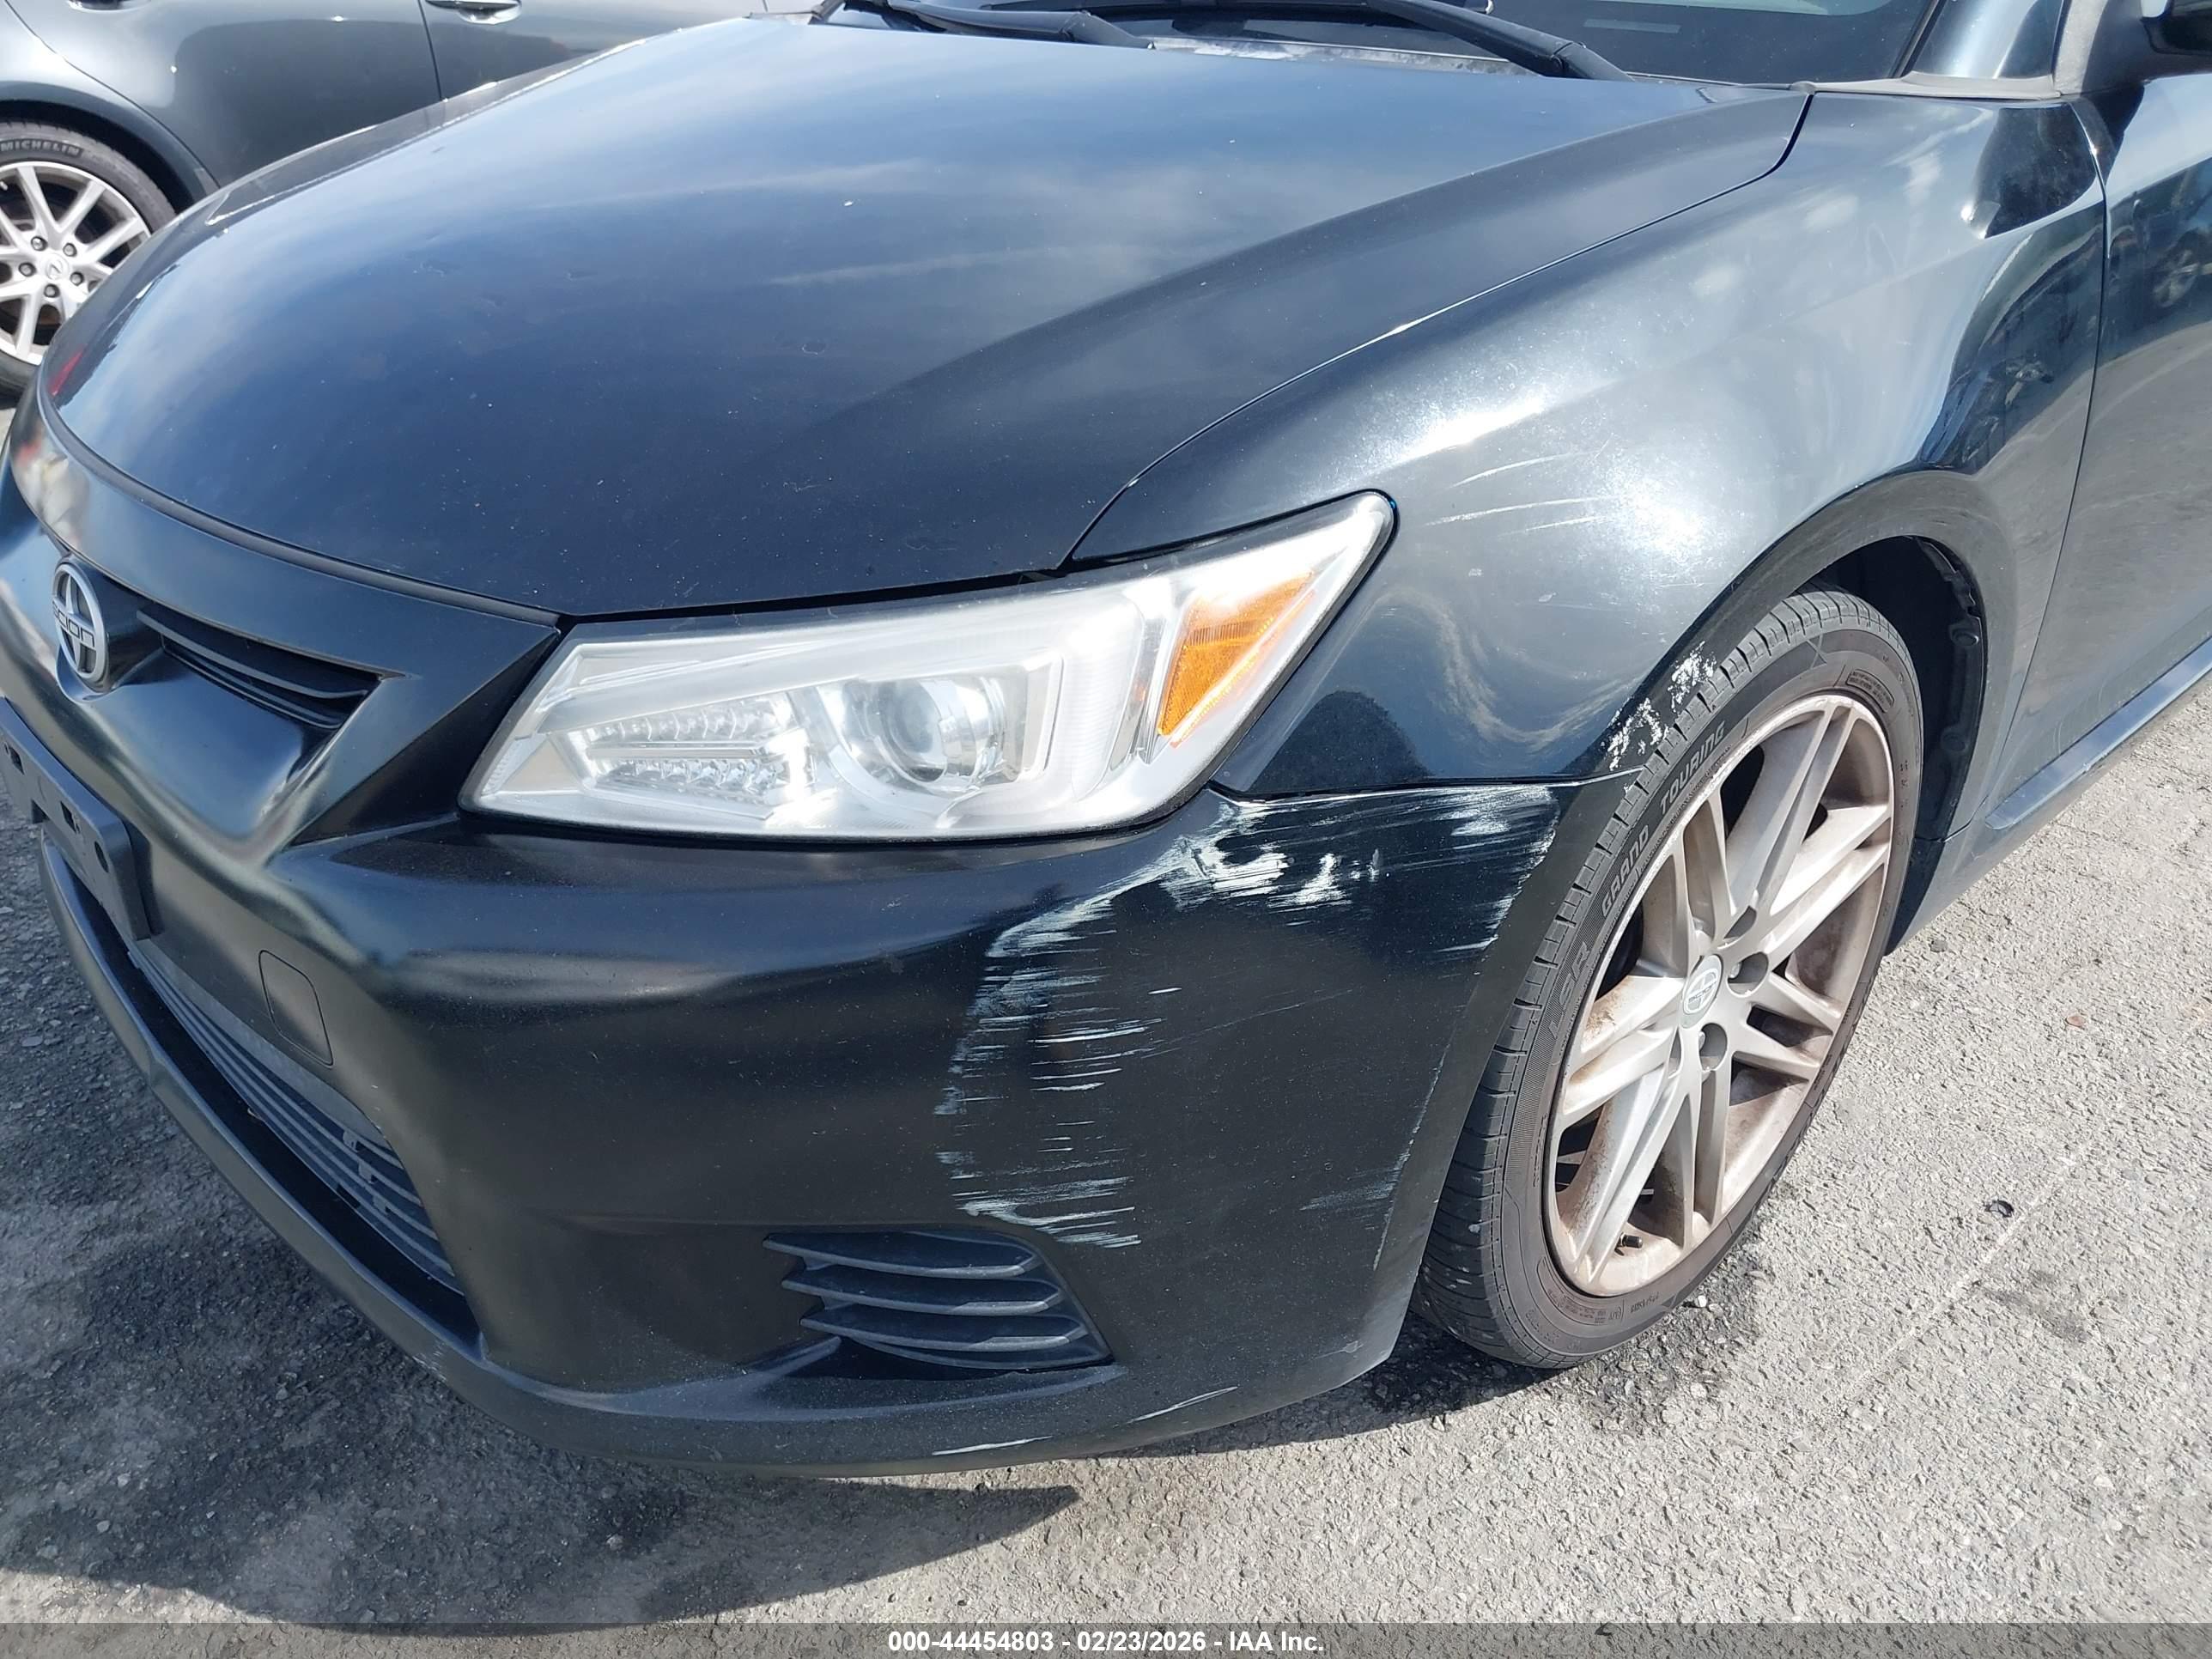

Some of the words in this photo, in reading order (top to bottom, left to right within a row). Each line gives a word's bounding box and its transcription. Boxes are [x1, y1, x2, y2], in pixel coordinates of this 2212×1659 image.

[1, 139, 81, 156] MICHELIN
[1601, 824, 1649, 918] GRAND
[1660, 720, 1725, 816] TOURING
